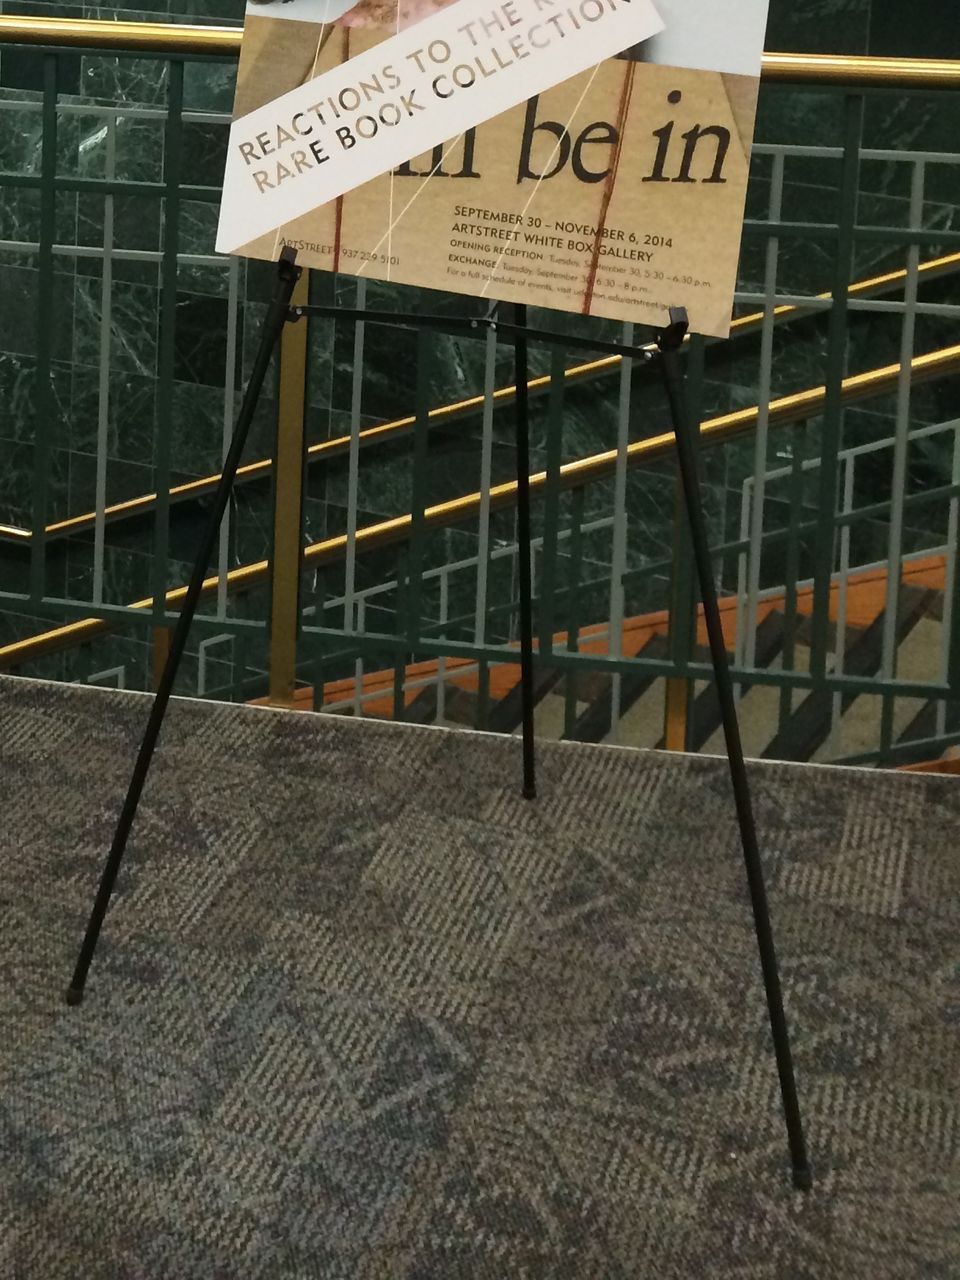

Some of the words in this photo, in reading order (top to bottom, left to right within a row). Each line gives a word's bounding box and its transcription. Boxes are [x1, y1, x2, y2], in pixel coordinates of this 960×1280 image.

[238, 65, 401, 165] REACTIONS
[405, 39, 451, 73] TO
[457, 0, 523, 47] THE
[252, 139, 330, 194] RARE
[335, 88, 426, 150] BOOK
[516, 93, 620, 185] be
[641, 89, 732, 184] in
[449, 239, 491, 253] OPENING
[493, 245, 544, 261] RECEPTION
[451, 223, 521, 241] ARTSTREET
[523, 232, 563, 249] WHITE
[567, 239, 594, 253] BOX
[598, 245, 654, 263] GALLERY
[453, 205, 524, 226] SEPTEMBER
[526, 217, 542, 228] 30
[554, 221, 625, 241] NOVEMBER
[628, 232, 639, 245] 6,
[643, 234, 673, 248] 2014
